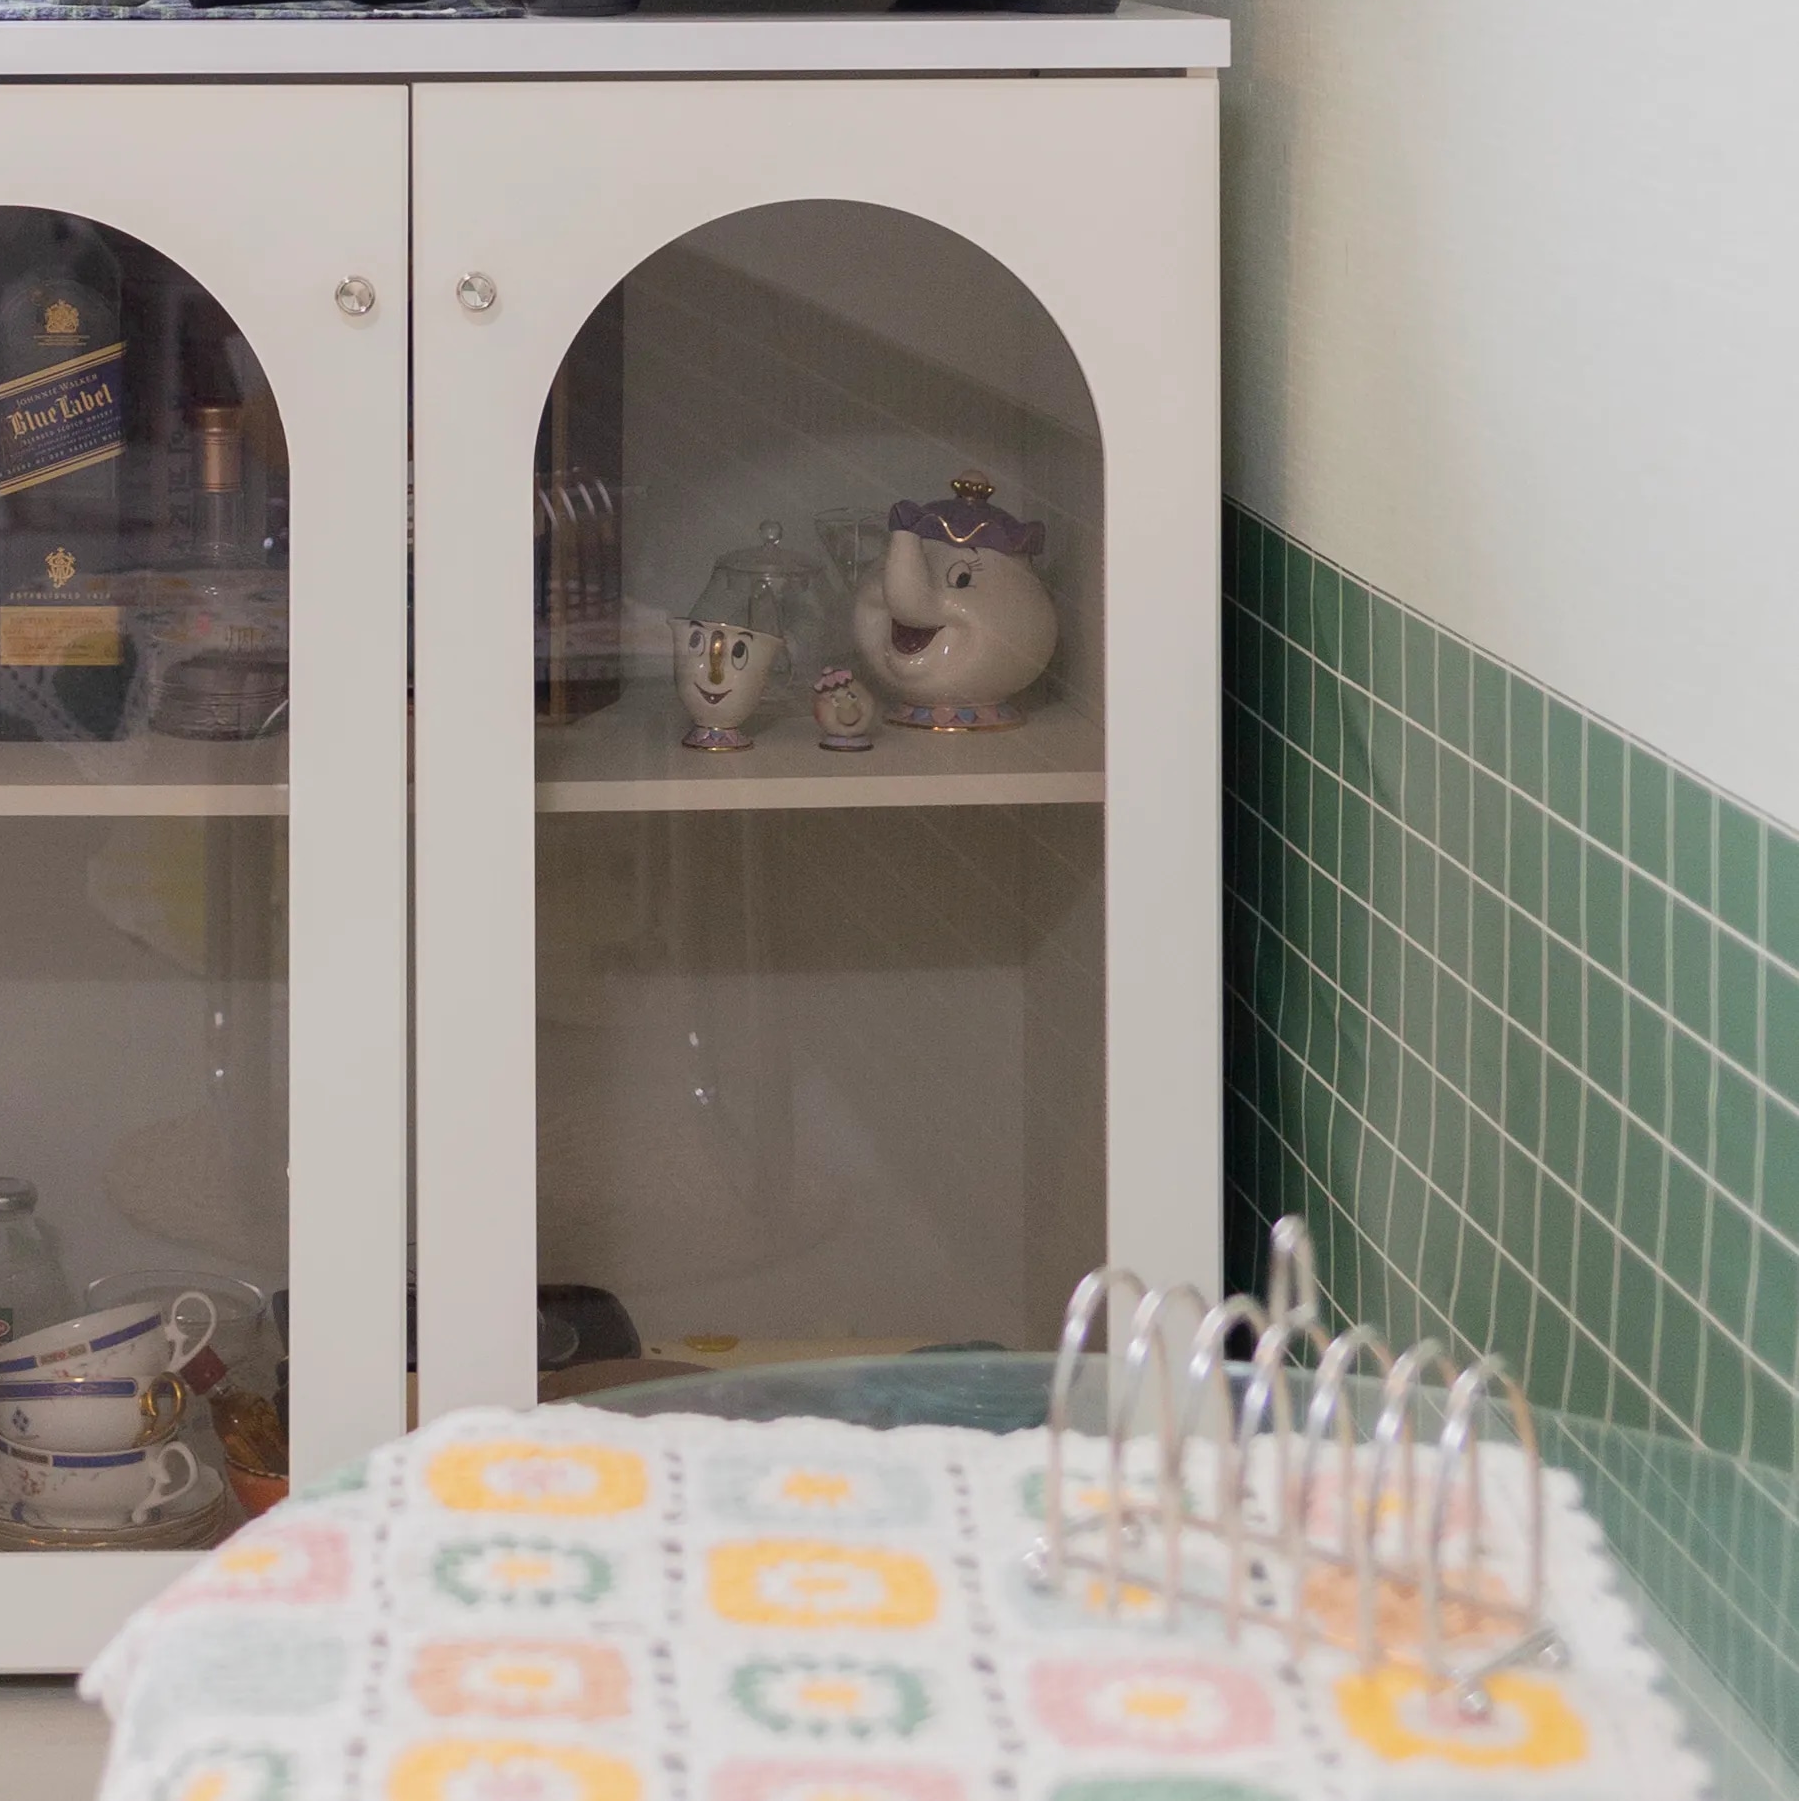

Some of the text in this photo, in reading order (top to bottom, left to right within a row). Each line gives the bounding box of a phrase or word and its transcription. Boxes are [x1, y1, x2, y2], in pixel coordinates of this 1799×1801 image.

[6, 406, 58, 439] Blue
[55, 383, 113, 422] Label
[16, 373, 99, 409] JOHNNIE WALKER
